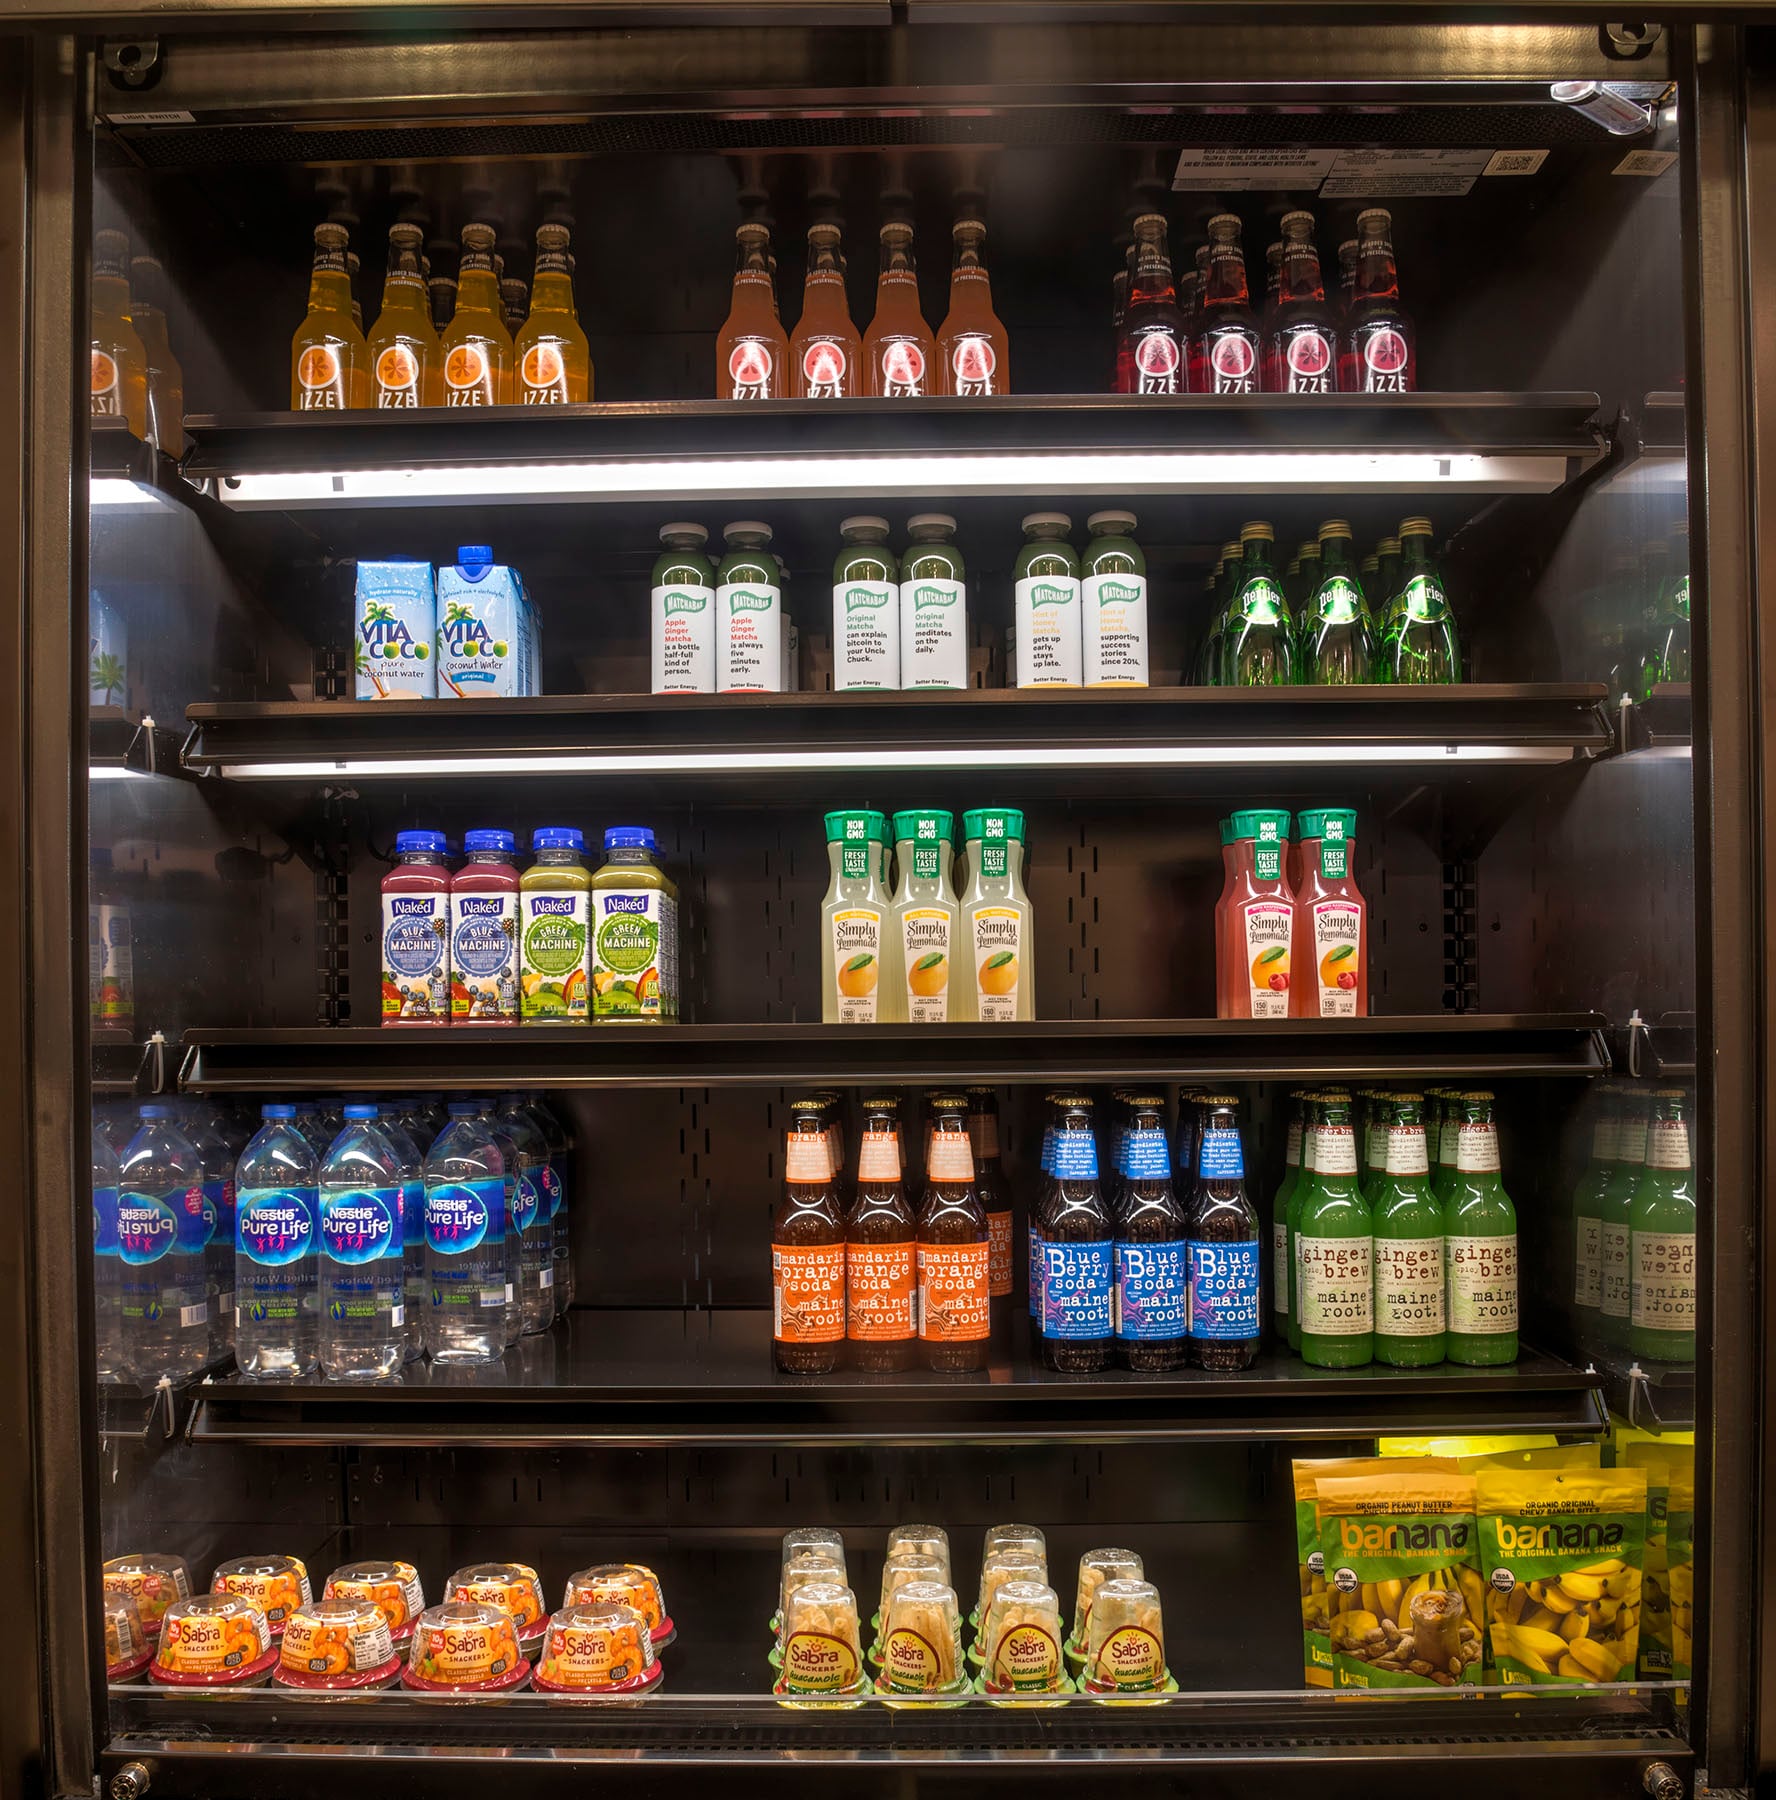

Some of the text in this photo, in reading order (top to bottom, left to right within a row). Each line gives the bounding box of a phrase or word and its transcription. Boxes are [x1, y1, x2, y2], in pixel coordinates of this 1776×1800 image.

[300, 392, 336, 410] IZZE
[448, 391, 480, 408] IZZE
[370, 588, 417, 597] hydrate naturally
[360, 619, 411, 643] VITA
[442, 619, 493, 643] VITA
[1033, 636, 1049, 644] gets
[1101, 634, 1139, 642] supporting
[370, 639, 429, 660] COCO
[450, 639, 508, 658] COCO
[381, 660, 404, 670] pure
[364, 670, 399, 678] coconut
[665, 668, 691, 676] person.
[847, 820, 864, 829] NON
[1260, 822, 1276, 831] NON
[847, 830, 864, 839] GMO
[1260, 831, 1276, 840] GMO
[1258, 852, 1278, 860] FRESH
[845, 860, 865, 868] TASTE
[395, 901, 431, 913] Naked
[464, 901, 500, 913] Naked
[536, 900, 572, 912] Naked
[608, 899, 645, 910] Naked
[978, 920, 1016, 937] Simply
[1250, 915, 1287, 933] Simply
[1319, 913, 1356, 932] Simply
[402, 927, 425, 937] BLUE
[470, 927, 493, 937] BLUE
[540, 925, 567, 937] GREEN
[613, 924, 640, 936] GREEN
[837, 922, 876, 939] Simply
[1318, 928, 1357, 942] Lemonade
[604, 938, 650, 948] MACHINE
[836, 936, 877, 950] Lemonade
[977, 935, 1017, 949] Lemonade
[1250, 930, 1289, 944] Lemonade
[391, 940, 436, 951] MACHINE
[460, 940, 505, 951] MACHINE
[531, 940, 577, 950] MACHINE
[425, 1210, 483, 1230] Pure Life
[242, 1219, 309, 1240] Pure Life
[323, 1219, 388, 1239] Pure Life
[782, 1253, 844, 1265] mandarin
[926, 1250, 988, 1263] mandarin
[1303, 1246, 1369, 1264] ginger
[1374, 1247, 1440, 1265] ginger
[782, 1265, 844, 1281] orange
[927, 1264, 988, 1280] orange
[1323, 1264, 1369, 1278] brew
[1394, 1265, 1439, 1279] brew
[790, 1279, 831, 1292] soda
[935, 1277, 976, 1290] soda
[1056, 1277, 1096, 1290] soda
[1205, 1277, 1246, 1289] soda
[800, 1294, 844, 1311] maine
[944, 1294, 987, 1310] maine
[1060, 1294, 1108, 1307] maine
[1210, 1293, 1256, 1307] maine
[1317, 1291, 1366, 1304] maine
[1387, 1291, 1437, 1305] maine
[950, 1311, 987, 1324] root.
[1065, 1308, 1108, 1321] root.
[1215, 1308, 1256, 1321] root.
[1323, 1305, 1366, 1318] root.
[805, 1312, 844, 1326] root.
[1423, 1501, 1452, 1509] BUTTER
[1341, 1519, 1468, 1549] barnana
[1496, 1517, 1624, 1550] barnana
[1343, 1549, 1440, 1558] THE ORIGINAL BANANA
[1517, 1549, 1555, 1558] ORIGINAL
[1594, 1545, 1623, 1553] SNACK
[181, 1625, 220, 1643] Sabra
[183, 1644, 220, 1652] SNACKERS
[446, 1635, 486, 1653] Sabra
[566, 1636, 606, 1656] Sabra
[891, 1640, 924, 1661] Sabra
[1009, 1639, 1045, 1657] Sabra
[449, 1653, 487, 1663] SNACKERS
[792, 1644, 839, 1664] Sabra
[568, 1657, 604, 1665] SNACKERS
[894, 1661, 921, 1669] SNACKERS
[790, 1670, 840, 1683] Guacamole
[891, 1667, 924, 1682] Guacamole
[1011, 1665, 1048, 1675] Guacamole
